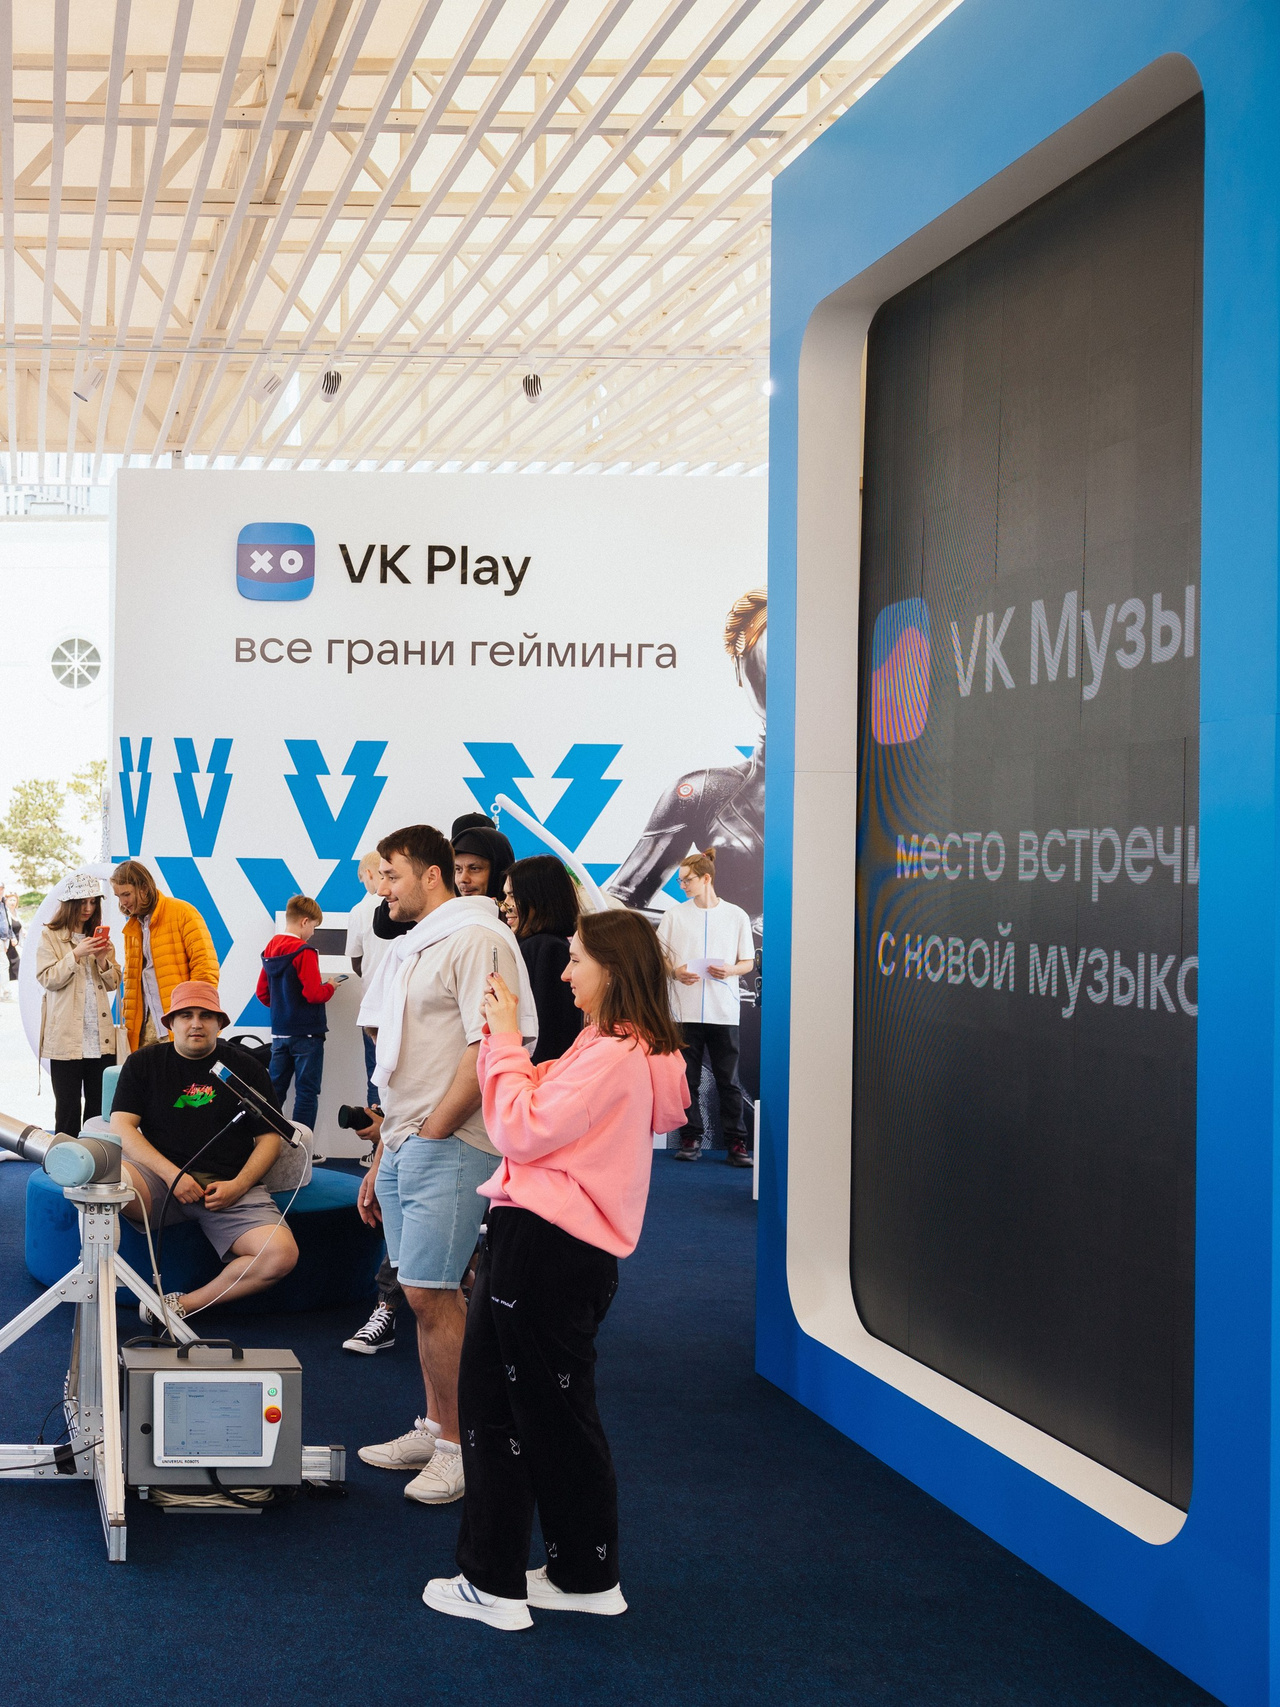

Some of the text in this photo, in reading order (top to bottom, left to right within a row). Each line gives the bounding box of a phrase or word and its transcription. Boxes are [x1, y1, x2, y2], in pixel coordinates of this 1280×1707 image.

[338, 543, 532, 597] VK Play
[234, 632, 678, 674] все грани гейминга
[950, 584, 1196, 701] VK Музы
[896, 830, 1006, 882] место
[877, 930, 896, 976] с
[904, 921, 1016, 992] новой
